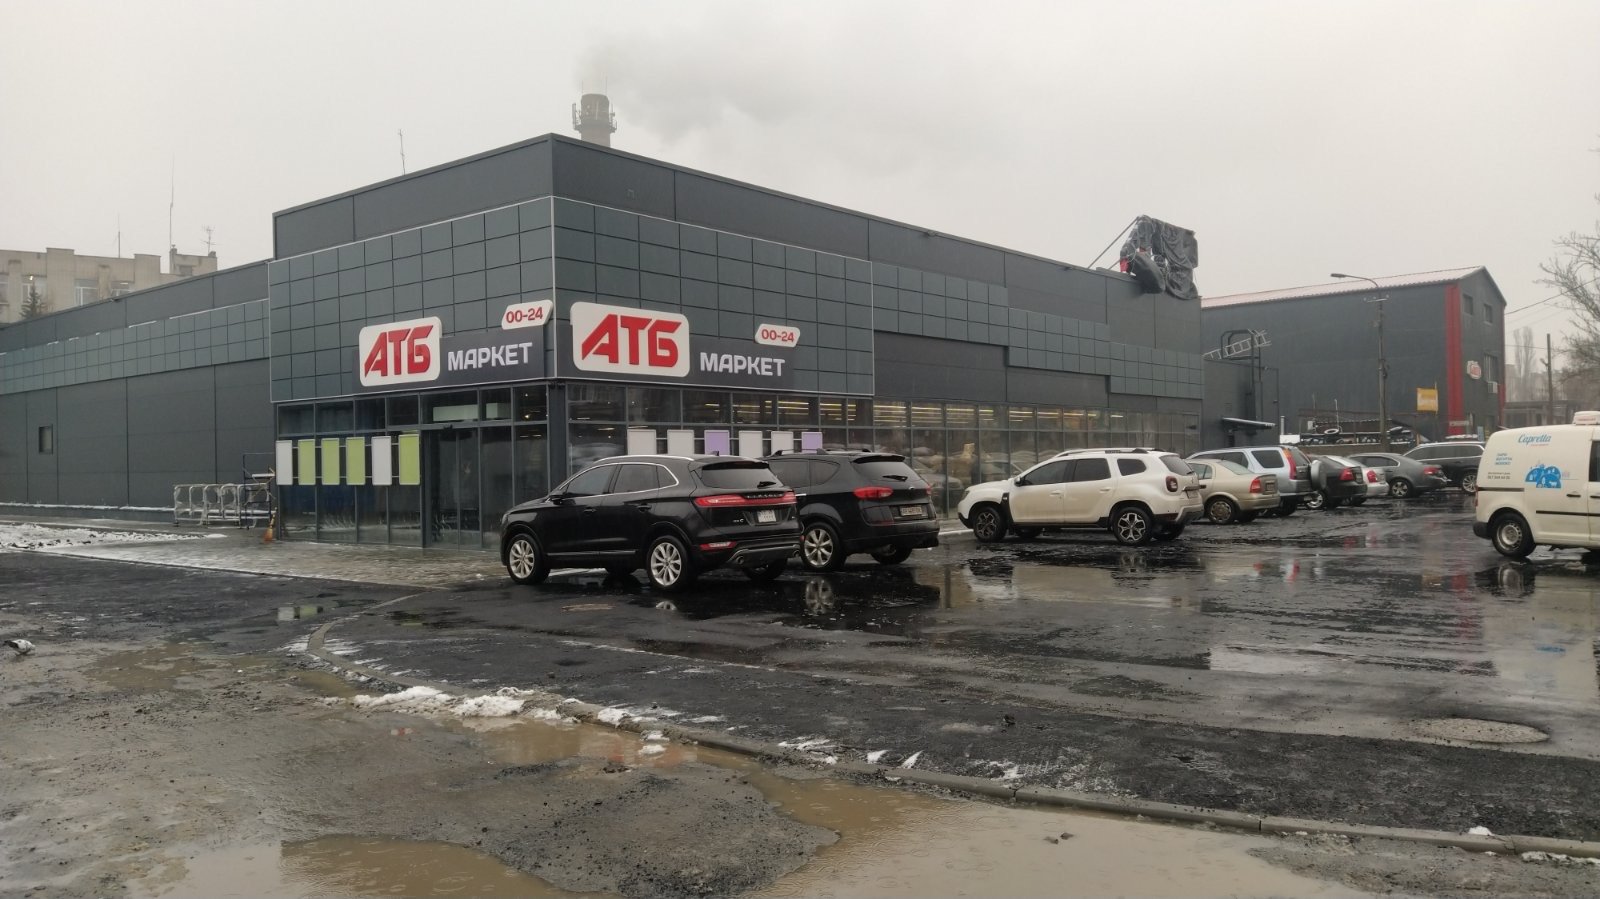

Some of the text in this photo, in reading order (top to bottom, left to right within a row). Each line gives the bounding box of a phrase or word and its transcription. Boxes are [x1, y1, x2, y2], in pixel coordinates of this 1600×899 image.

[505, 306, 543, 324] 00-24
[581, 313, 682, 368] АТБ
[761, 328, 795, 343] 00-24
[364, 325, 434, 378] АТБ
[447, 342, 533, 371] МАРКЕТ
[700, 352, 786, 377] МАРКЕТ
